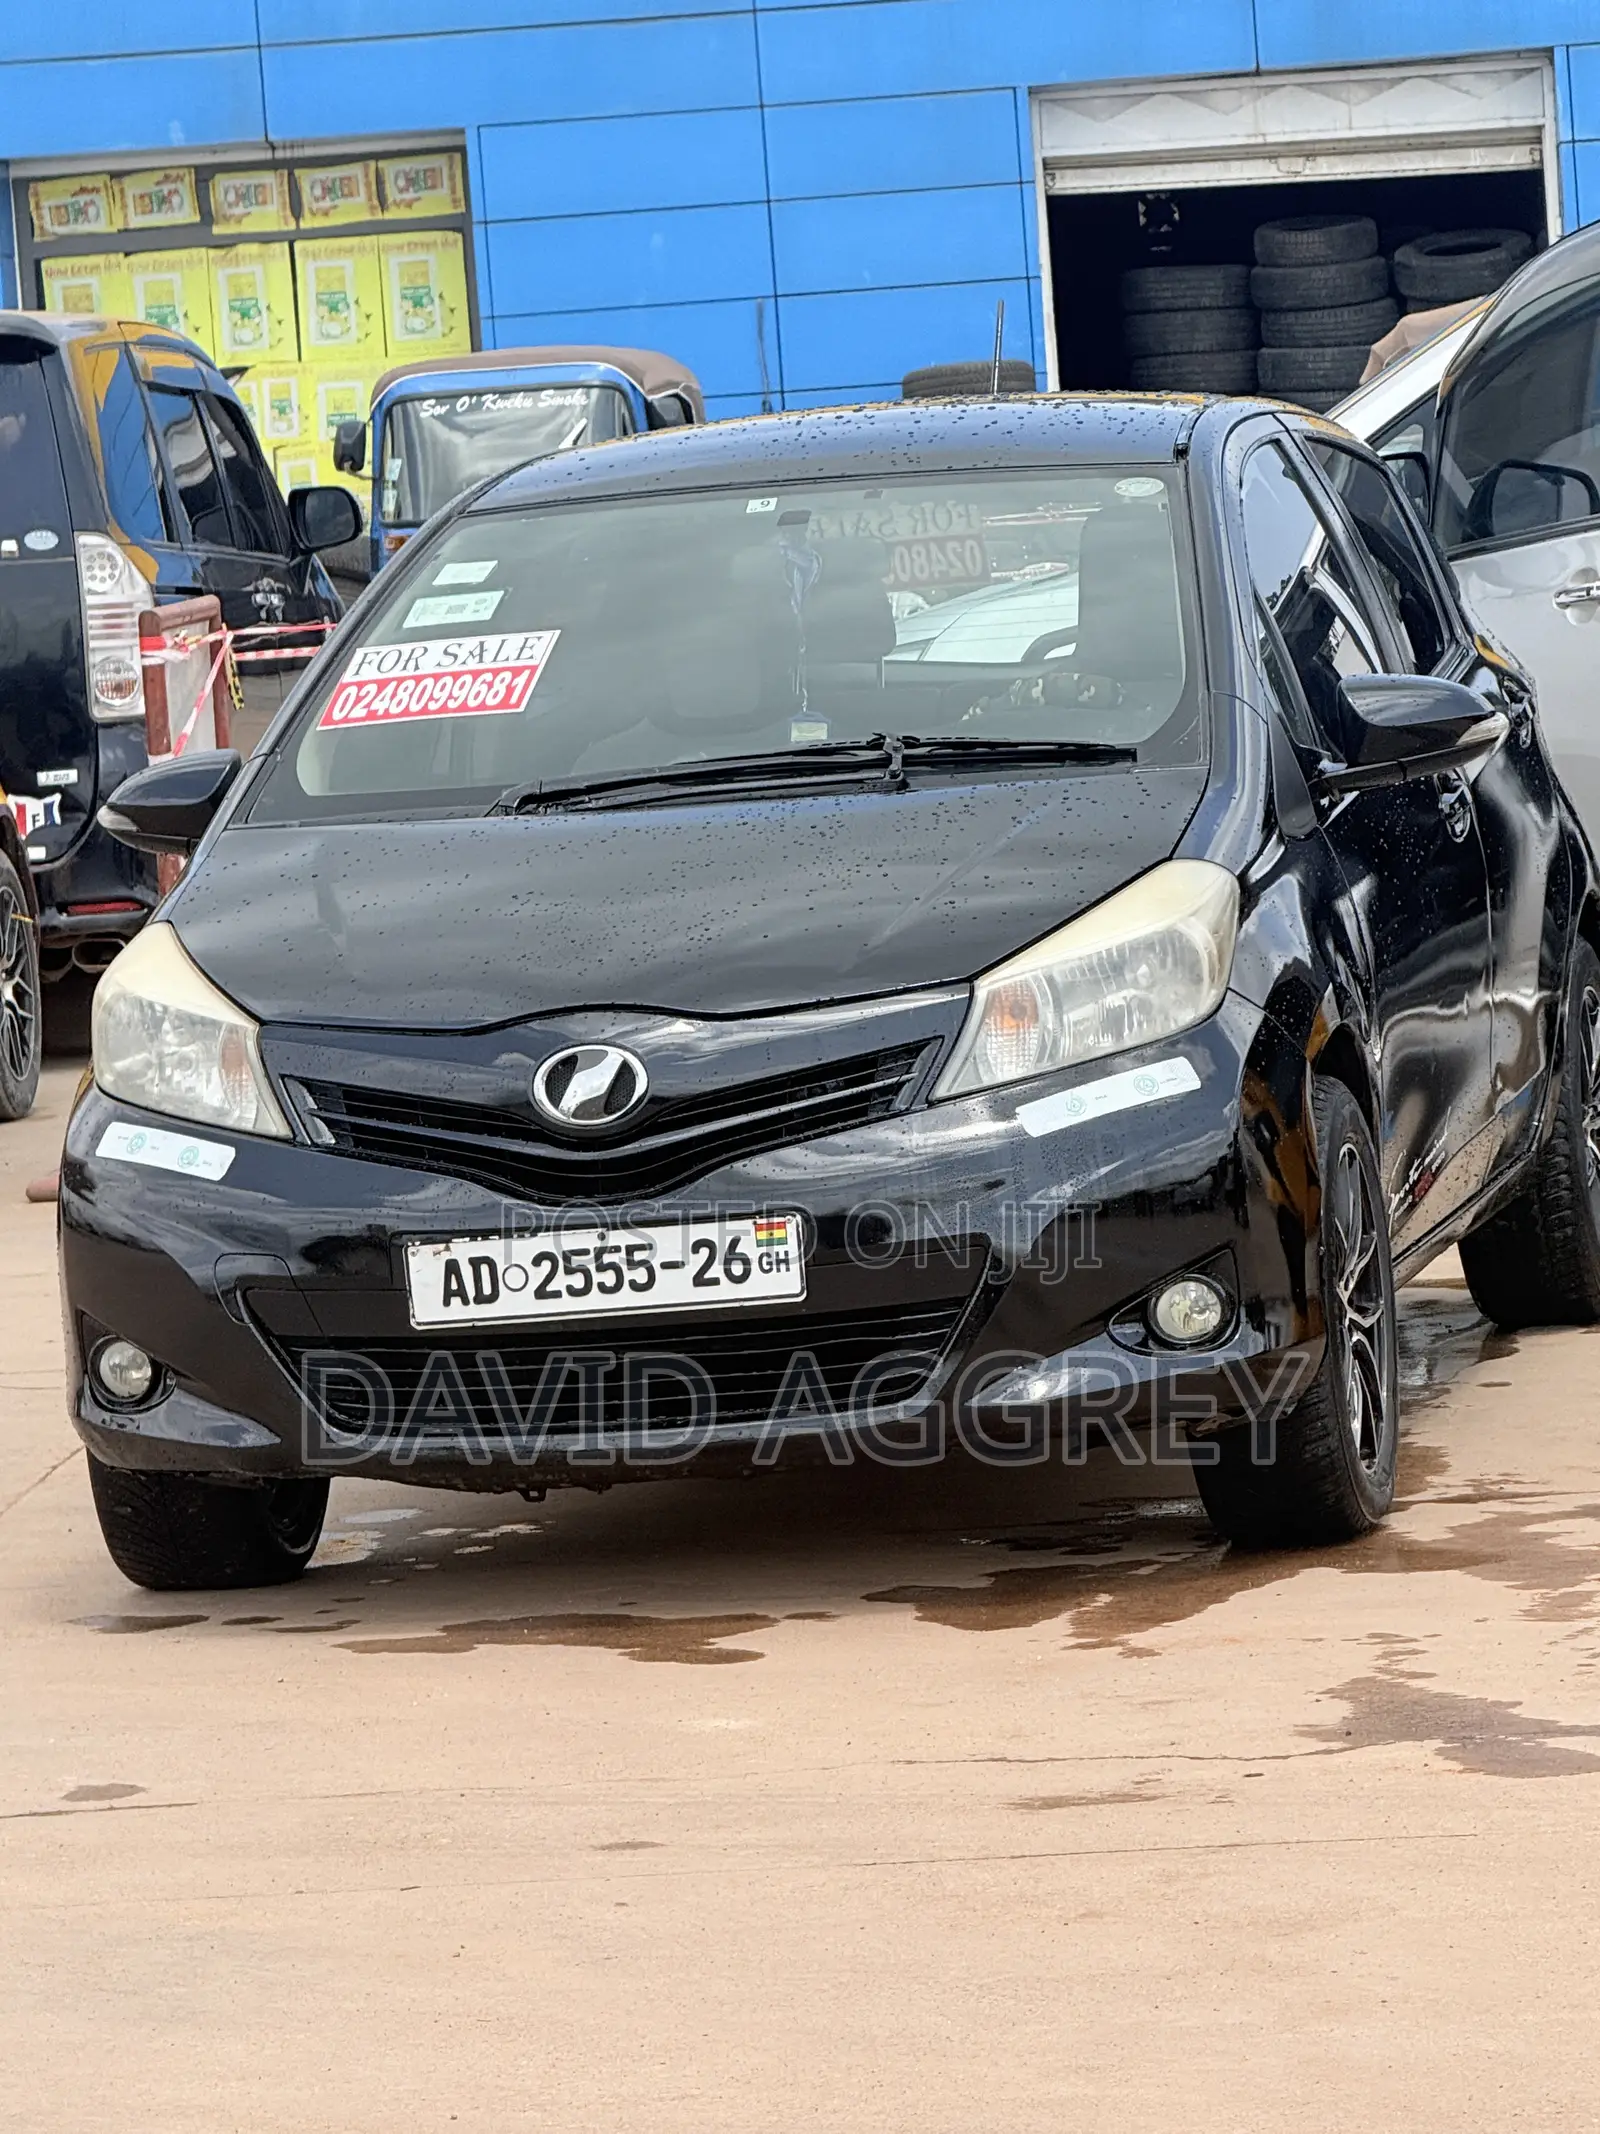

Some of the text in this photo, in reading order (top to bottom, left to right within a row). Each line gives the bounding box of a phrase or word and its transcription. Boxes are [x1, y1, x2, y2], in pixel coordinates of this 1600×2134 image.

[537, 388, 589, 408] Smoke
[351, 636, 544, 677] FOR SALE
[332, 669, 531, 721] 0248099681
[442, 1235, 752, 1308] AD 2555-26
[758, 1250, 791, 1275] GH
